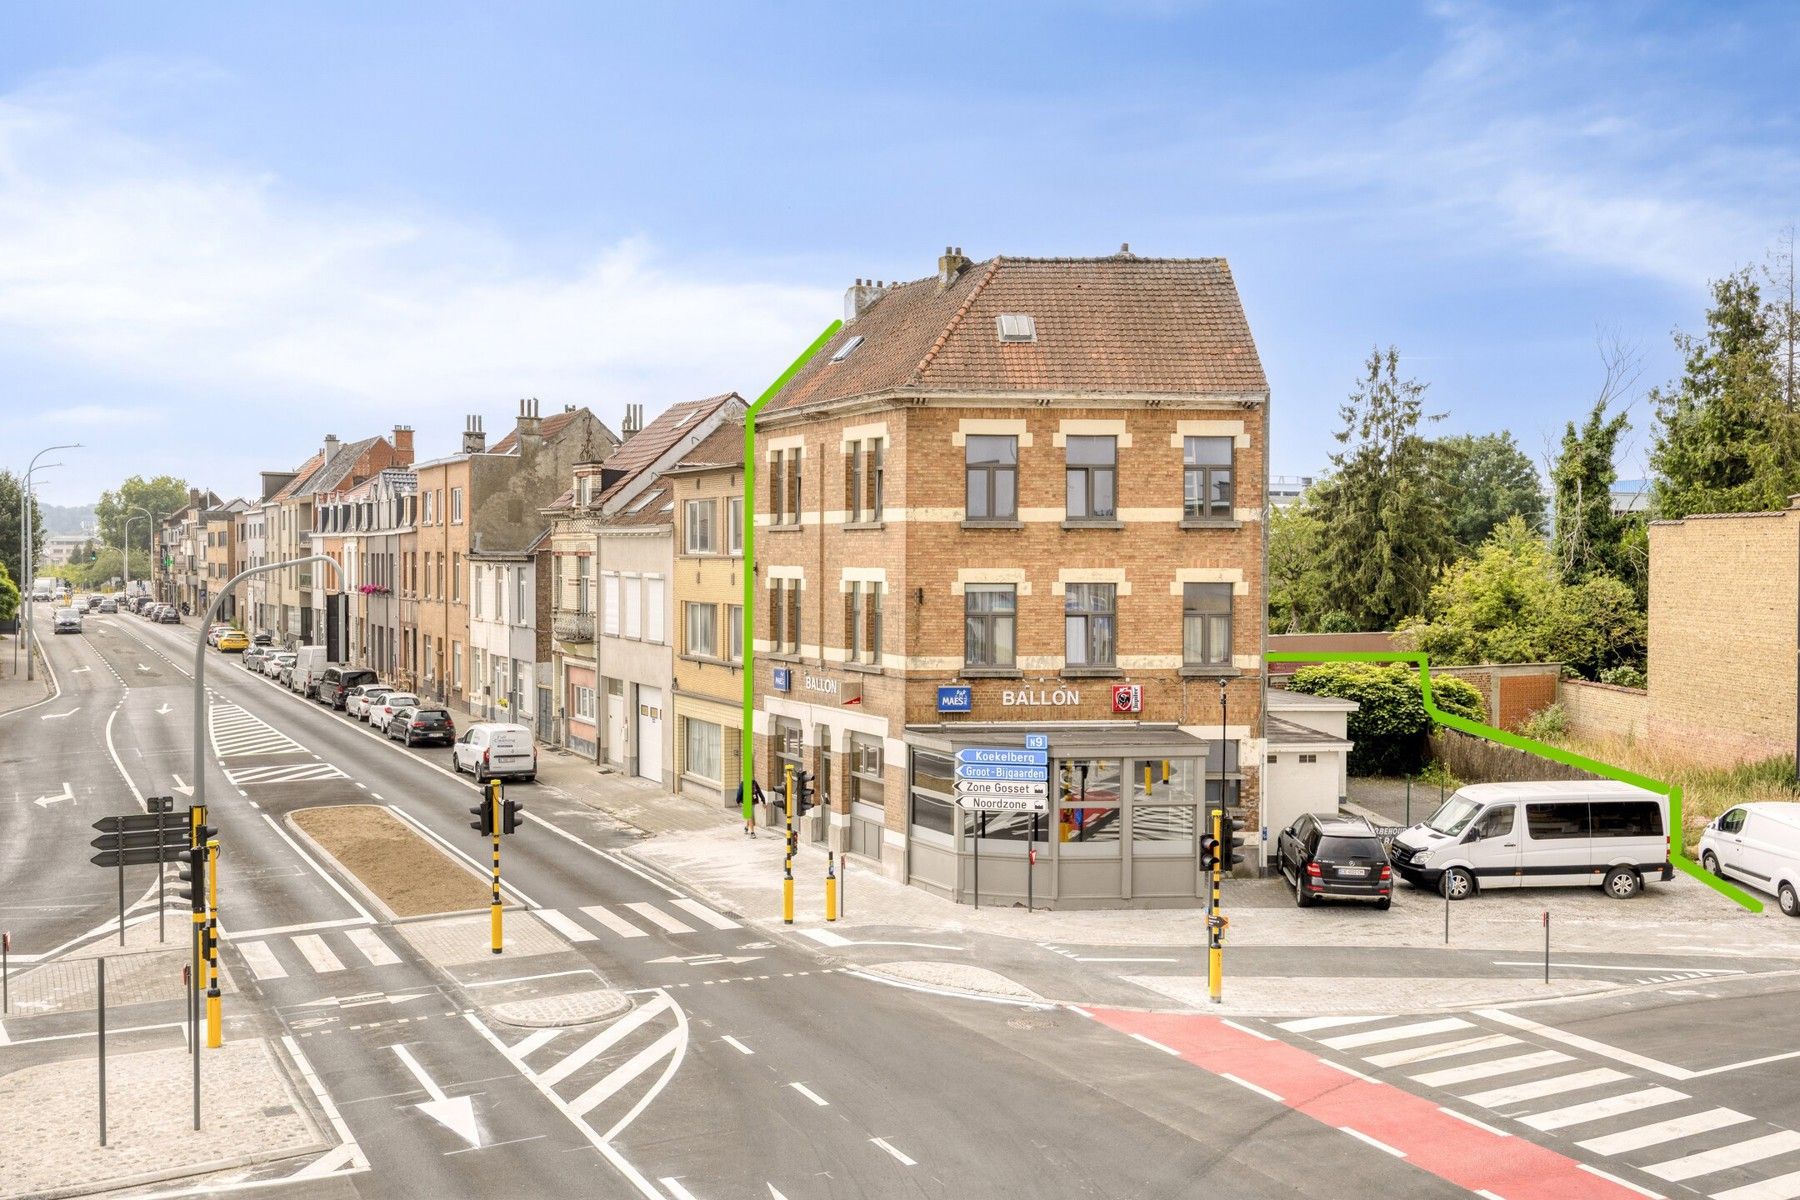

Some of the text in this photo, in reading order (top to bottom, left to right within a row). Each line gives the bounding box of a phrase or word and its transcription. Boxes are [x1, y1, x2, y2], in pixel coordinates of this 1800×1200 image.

[805, 676, 837, 693] BALLON
[942, 697, 964, 706] MAES
[1002, 690, 1079, 705] BALLON
[1030, 737, 1043, 747] N9
[975, 751, 1035, 764] Koekelberg
[966, 766, 1044, 779] Groot-Bijgaarden
[967, 782, 1030, 793] Zone Gosset
[973, 798, 1027, 809] Noordzone
